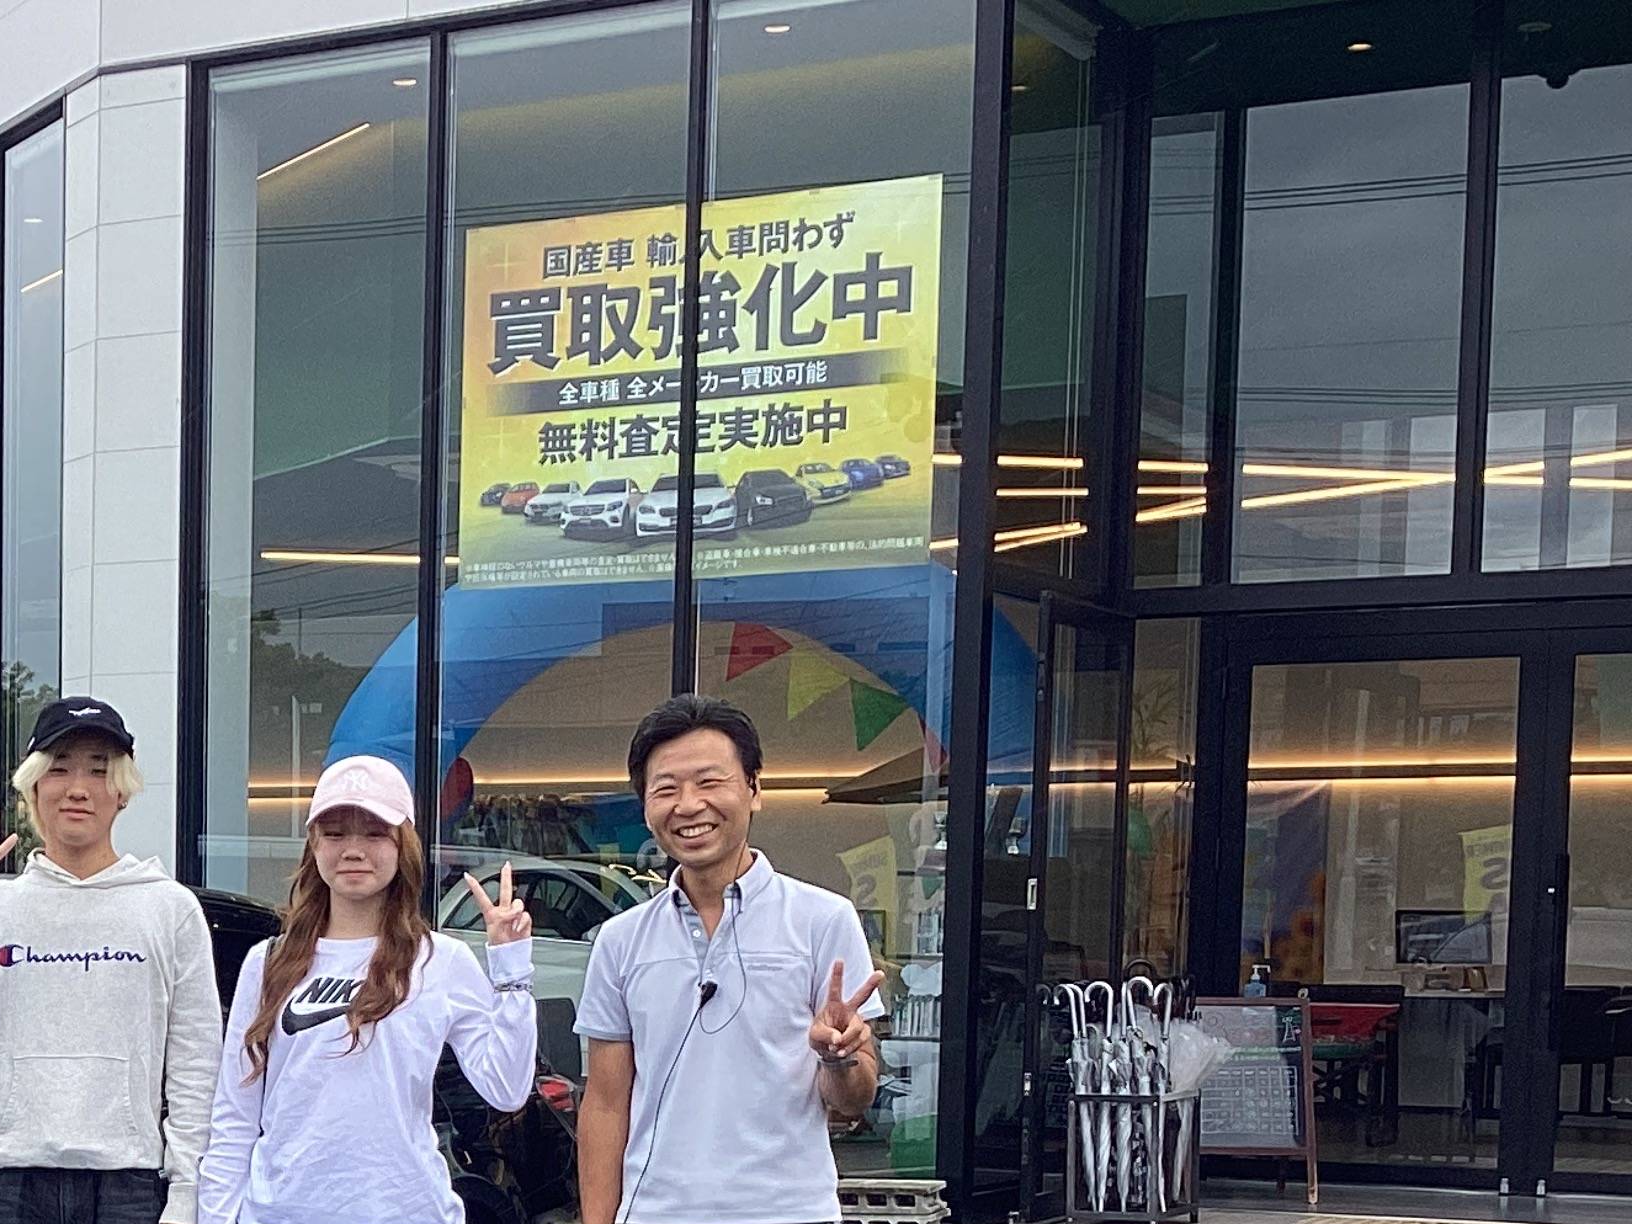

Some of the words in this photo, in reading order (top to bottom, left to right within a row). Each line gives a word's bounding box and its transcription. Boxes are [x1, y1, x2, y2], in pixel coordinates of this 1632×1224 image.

[542, 237, 635, 279] 国産車
[487, 251, 914, 376] 買取強化中
[558, 378, 620, 406] 全車種
[538, 398, 848, 465] 無料査定実施中
[295, 977, 367, 1004] NIK
